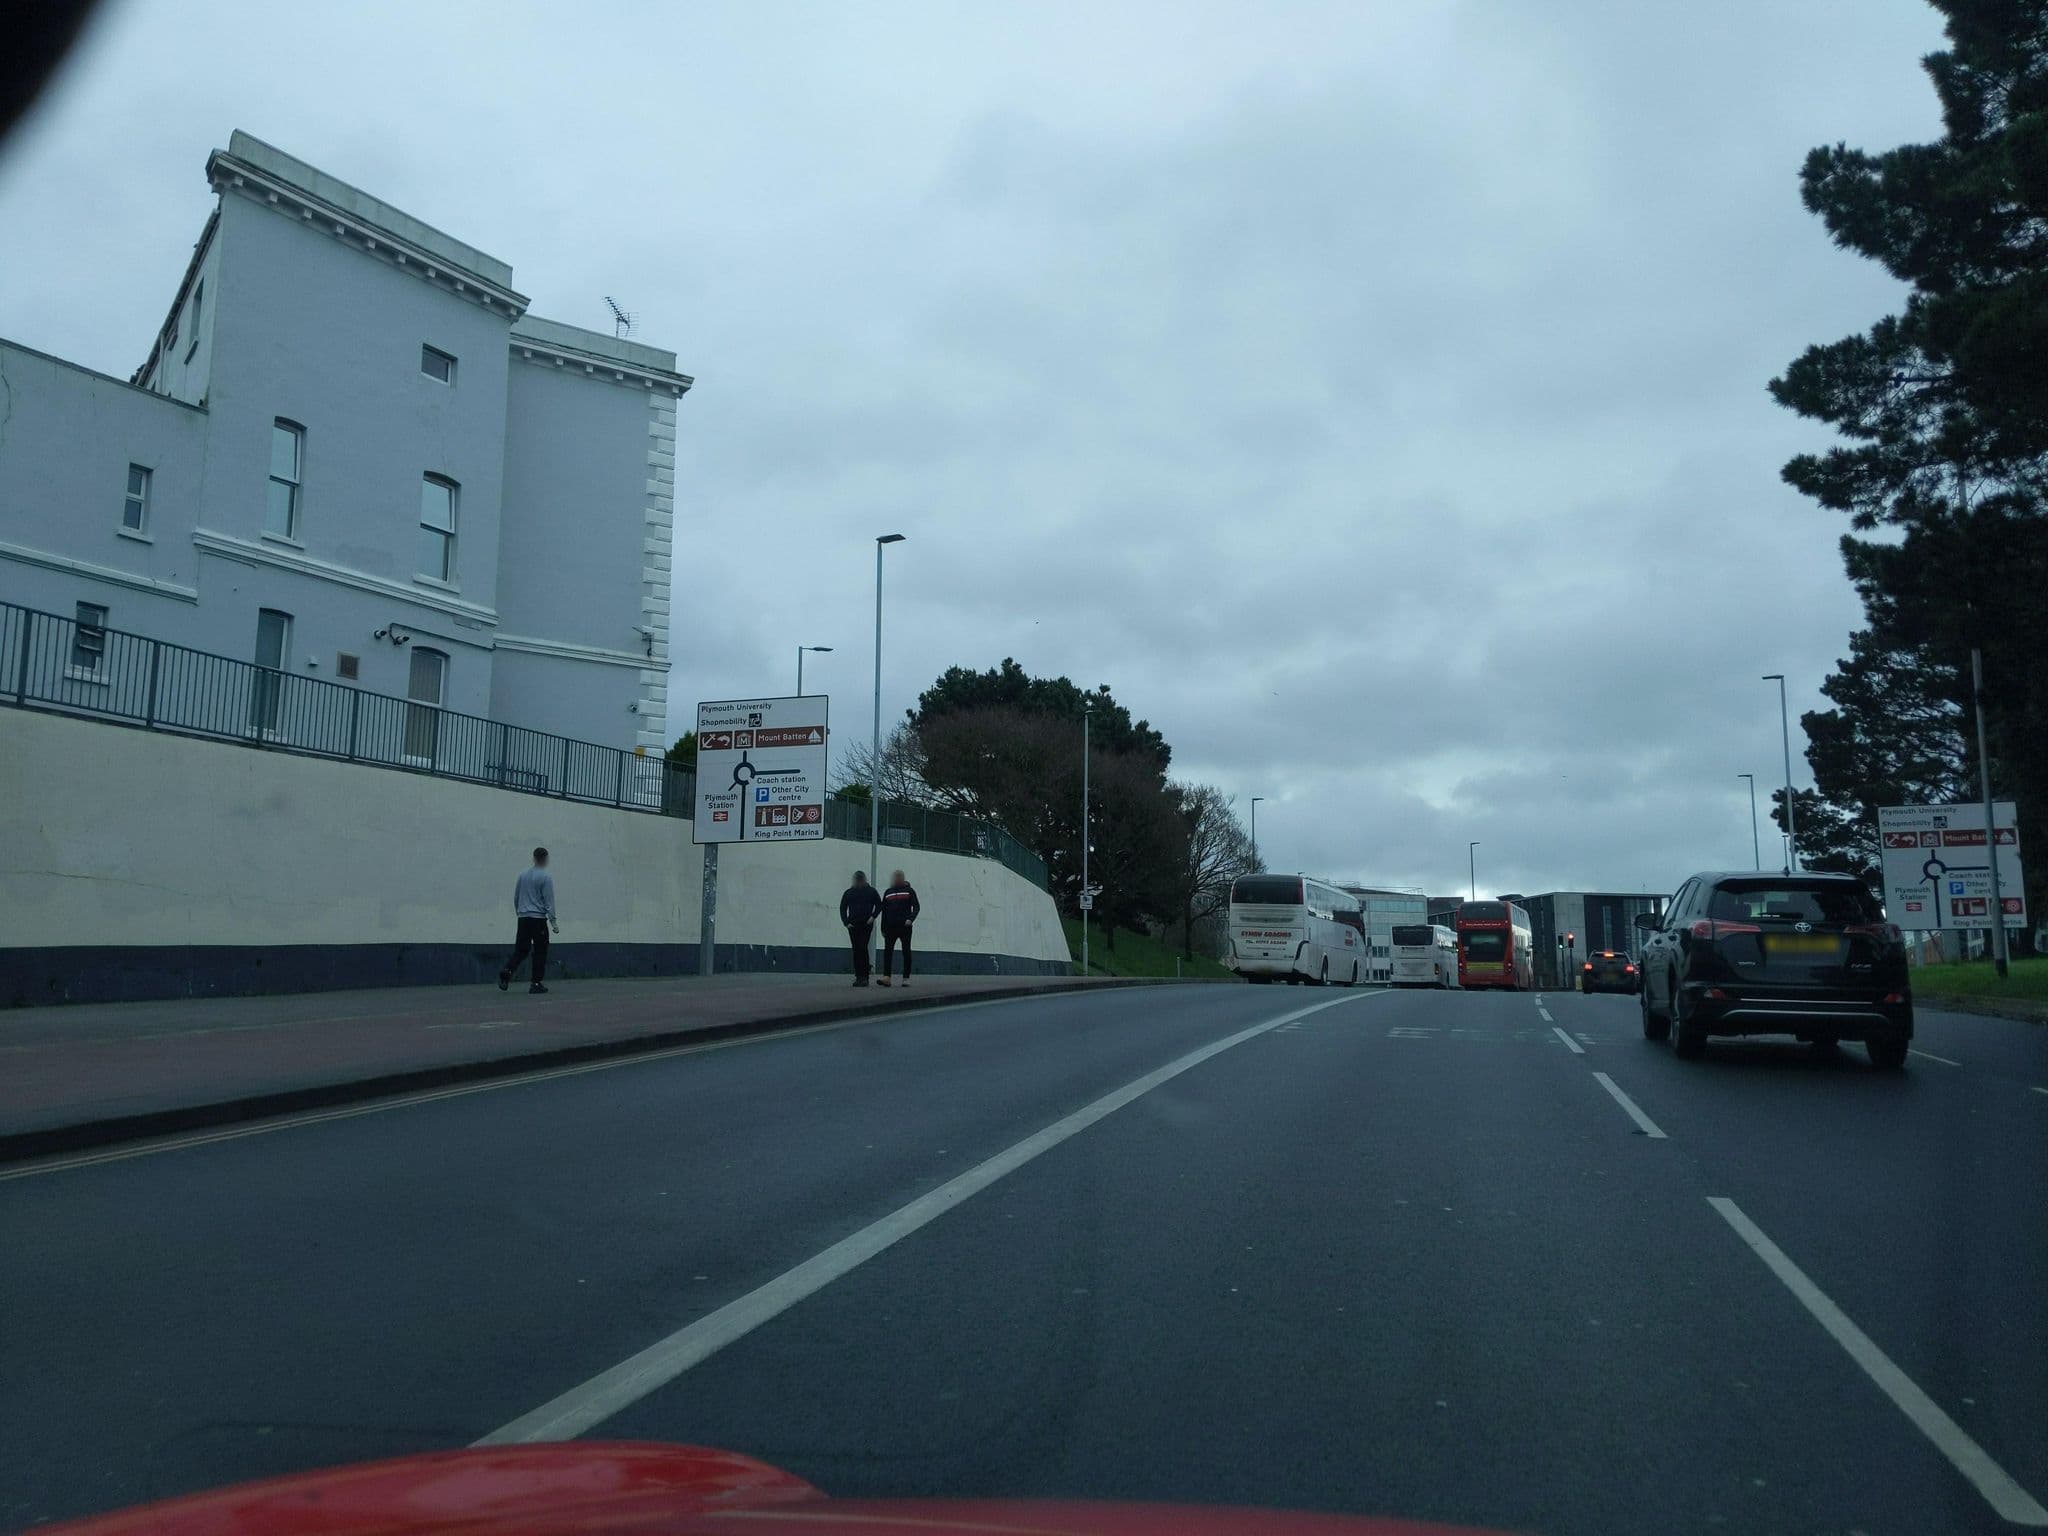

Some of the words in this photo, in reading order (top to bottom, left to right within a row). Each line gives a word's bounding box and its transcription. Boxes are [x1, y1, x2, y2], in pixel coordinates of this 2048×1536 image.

[701, 705, 735, 713] Plymouth
[736, 703, 772, 712] University
[700, 717, 748, 727] Shopmobility
[758, 734, 780, 742] Mount
[782, 733, 807, 741] Batten
[757, 776, 778, 785] Coach
[771, 786, 792, 794] Other
[794, 785, 810, 794] City
[704, 793, 738, 802] Plymouth
[708, 801, 735, 809] Station
[1880, 808, 1917, 816] Plymouth
[1882, 820, 1932, 829] Shopmobility
[754, 830, 771, 839] King
[772, 829, 792, 837] Point
[794, 829, 819, 837] Marina
[1895, 887, 1931, 895] Plymouth
[1953, 919, 1970, 927] King
